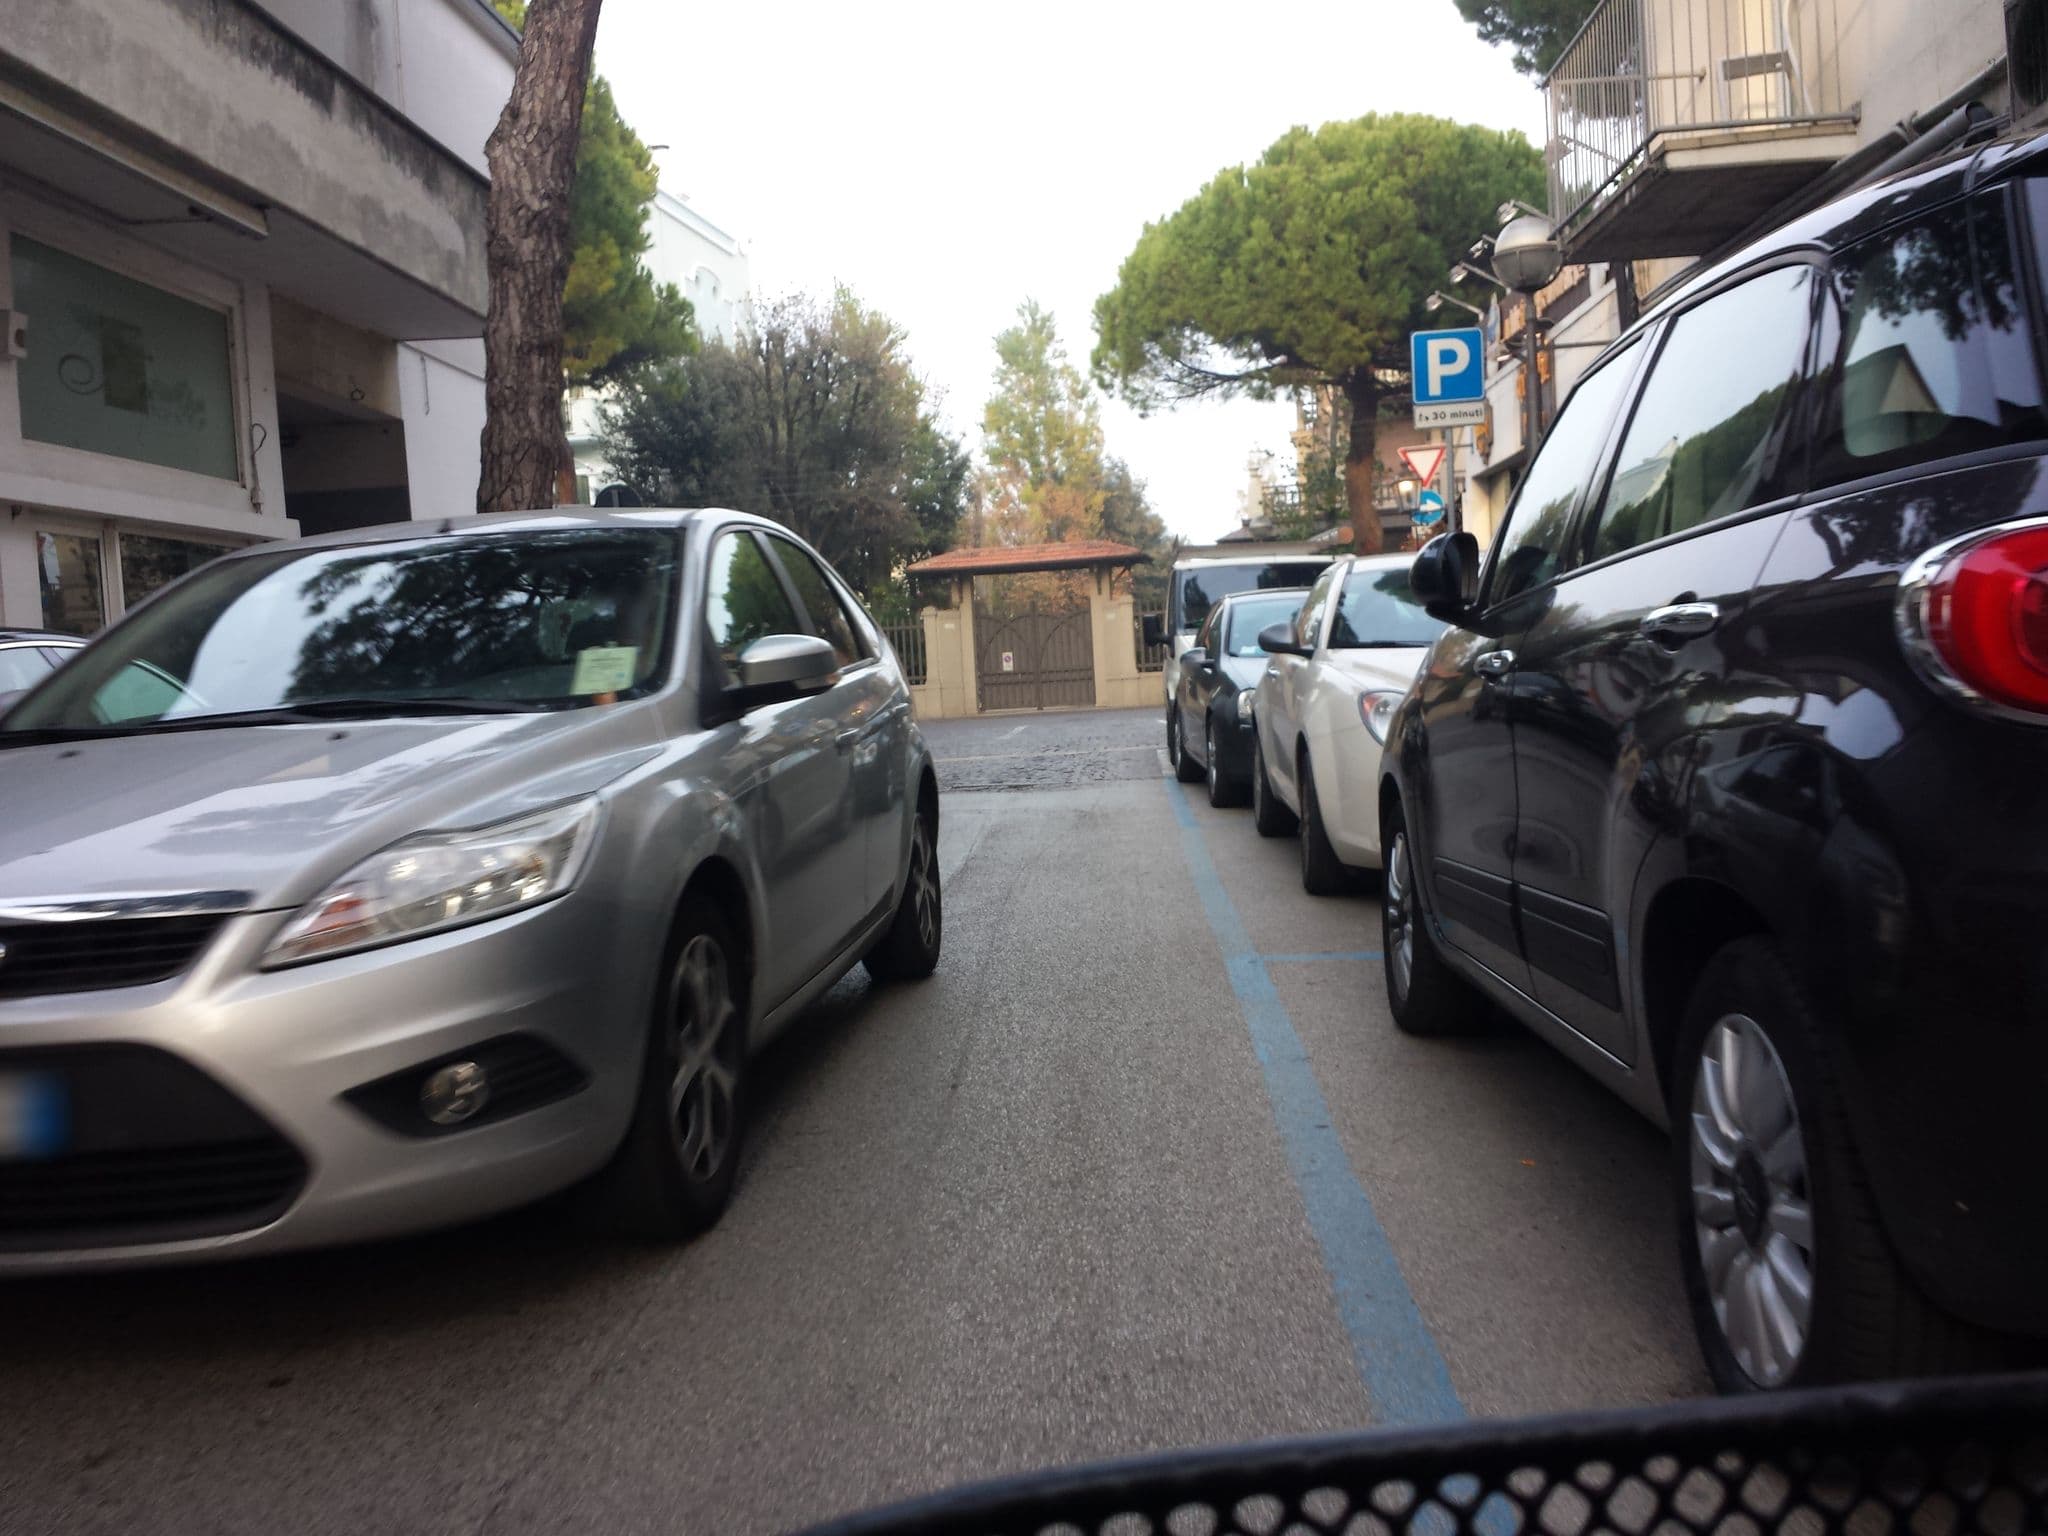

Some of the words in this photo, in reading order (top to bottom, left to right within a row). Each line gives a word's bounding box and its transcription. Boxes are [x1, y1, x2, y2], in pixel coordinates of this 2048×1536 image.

[1427, 338, 1470, 397] P
[1432, 411, 1447, 420] 30
[1449, 408, 1483, 418] minuti
